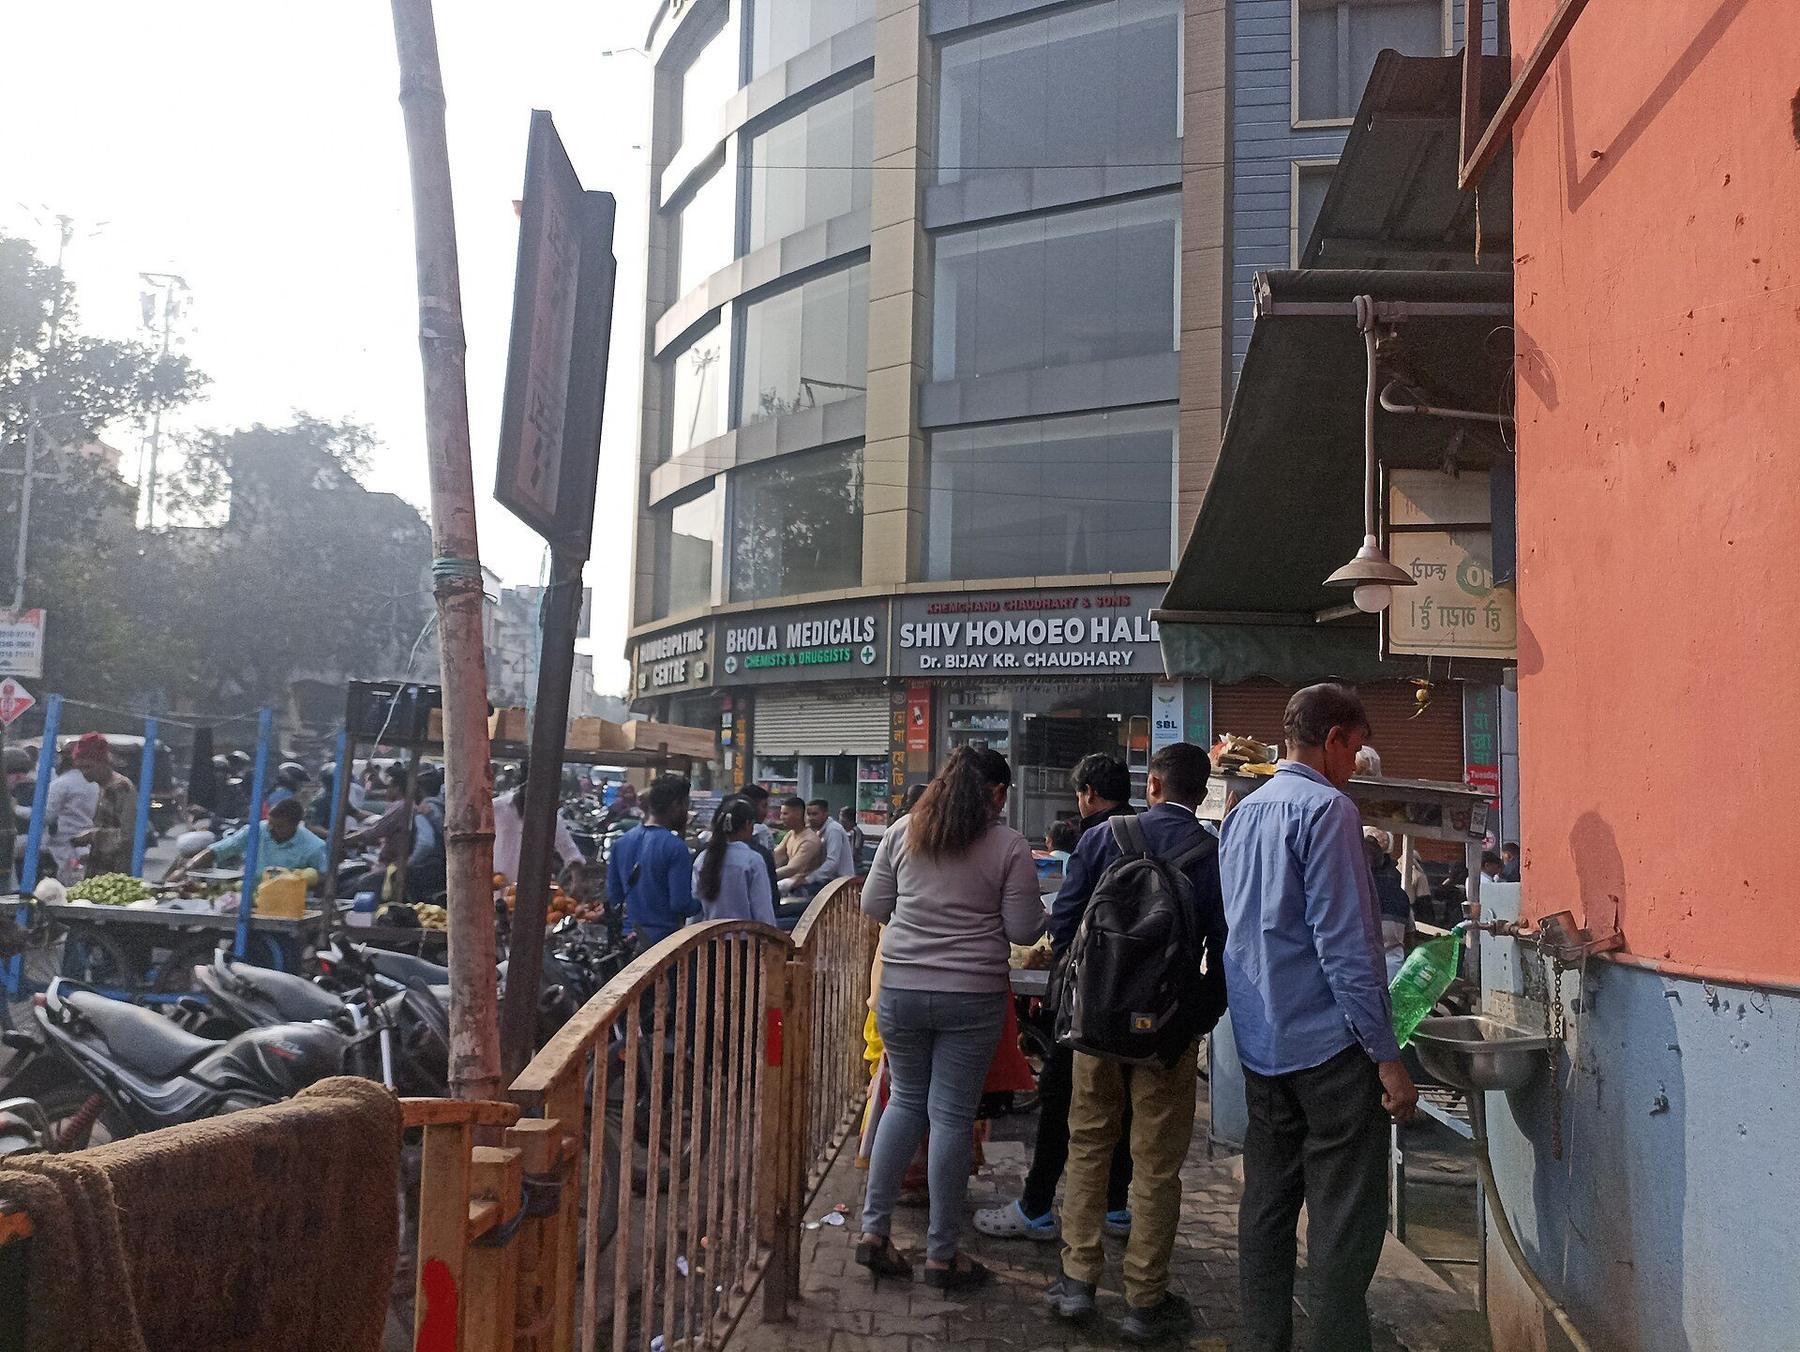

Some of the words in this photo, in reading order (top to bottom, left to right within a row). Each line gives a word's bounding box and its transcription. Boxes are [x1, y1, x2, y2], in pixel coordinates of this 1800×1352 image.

[1003, 597, 1078, 611] CHAUDHARY
[1096, 595, 1131, 607] SONS
[726, 625, 778, 653] BHOLA
[786, 616, 875, 649] MEDICALS
[900, 622, 960, 648] SHIV
[966, 618, 1085, 646] HOMOEO
[1090, 616, 1161, 643] HALL
[744, 653, 787, 669] CHEMISTS
[788, 652, 796, 666] &
[798, 648, 852, 665] DRUGGISTS
[920, 655, 942, 669] Dr.
[945, 653, 988, 669] BIJAY
[993, 653, 1020, 668] KR.
[1023, 650, 1134, 668] CHAUDHARY
[653, 659, 687, 687] CENTRE
[1155, 720, 1178, 729] SBL
